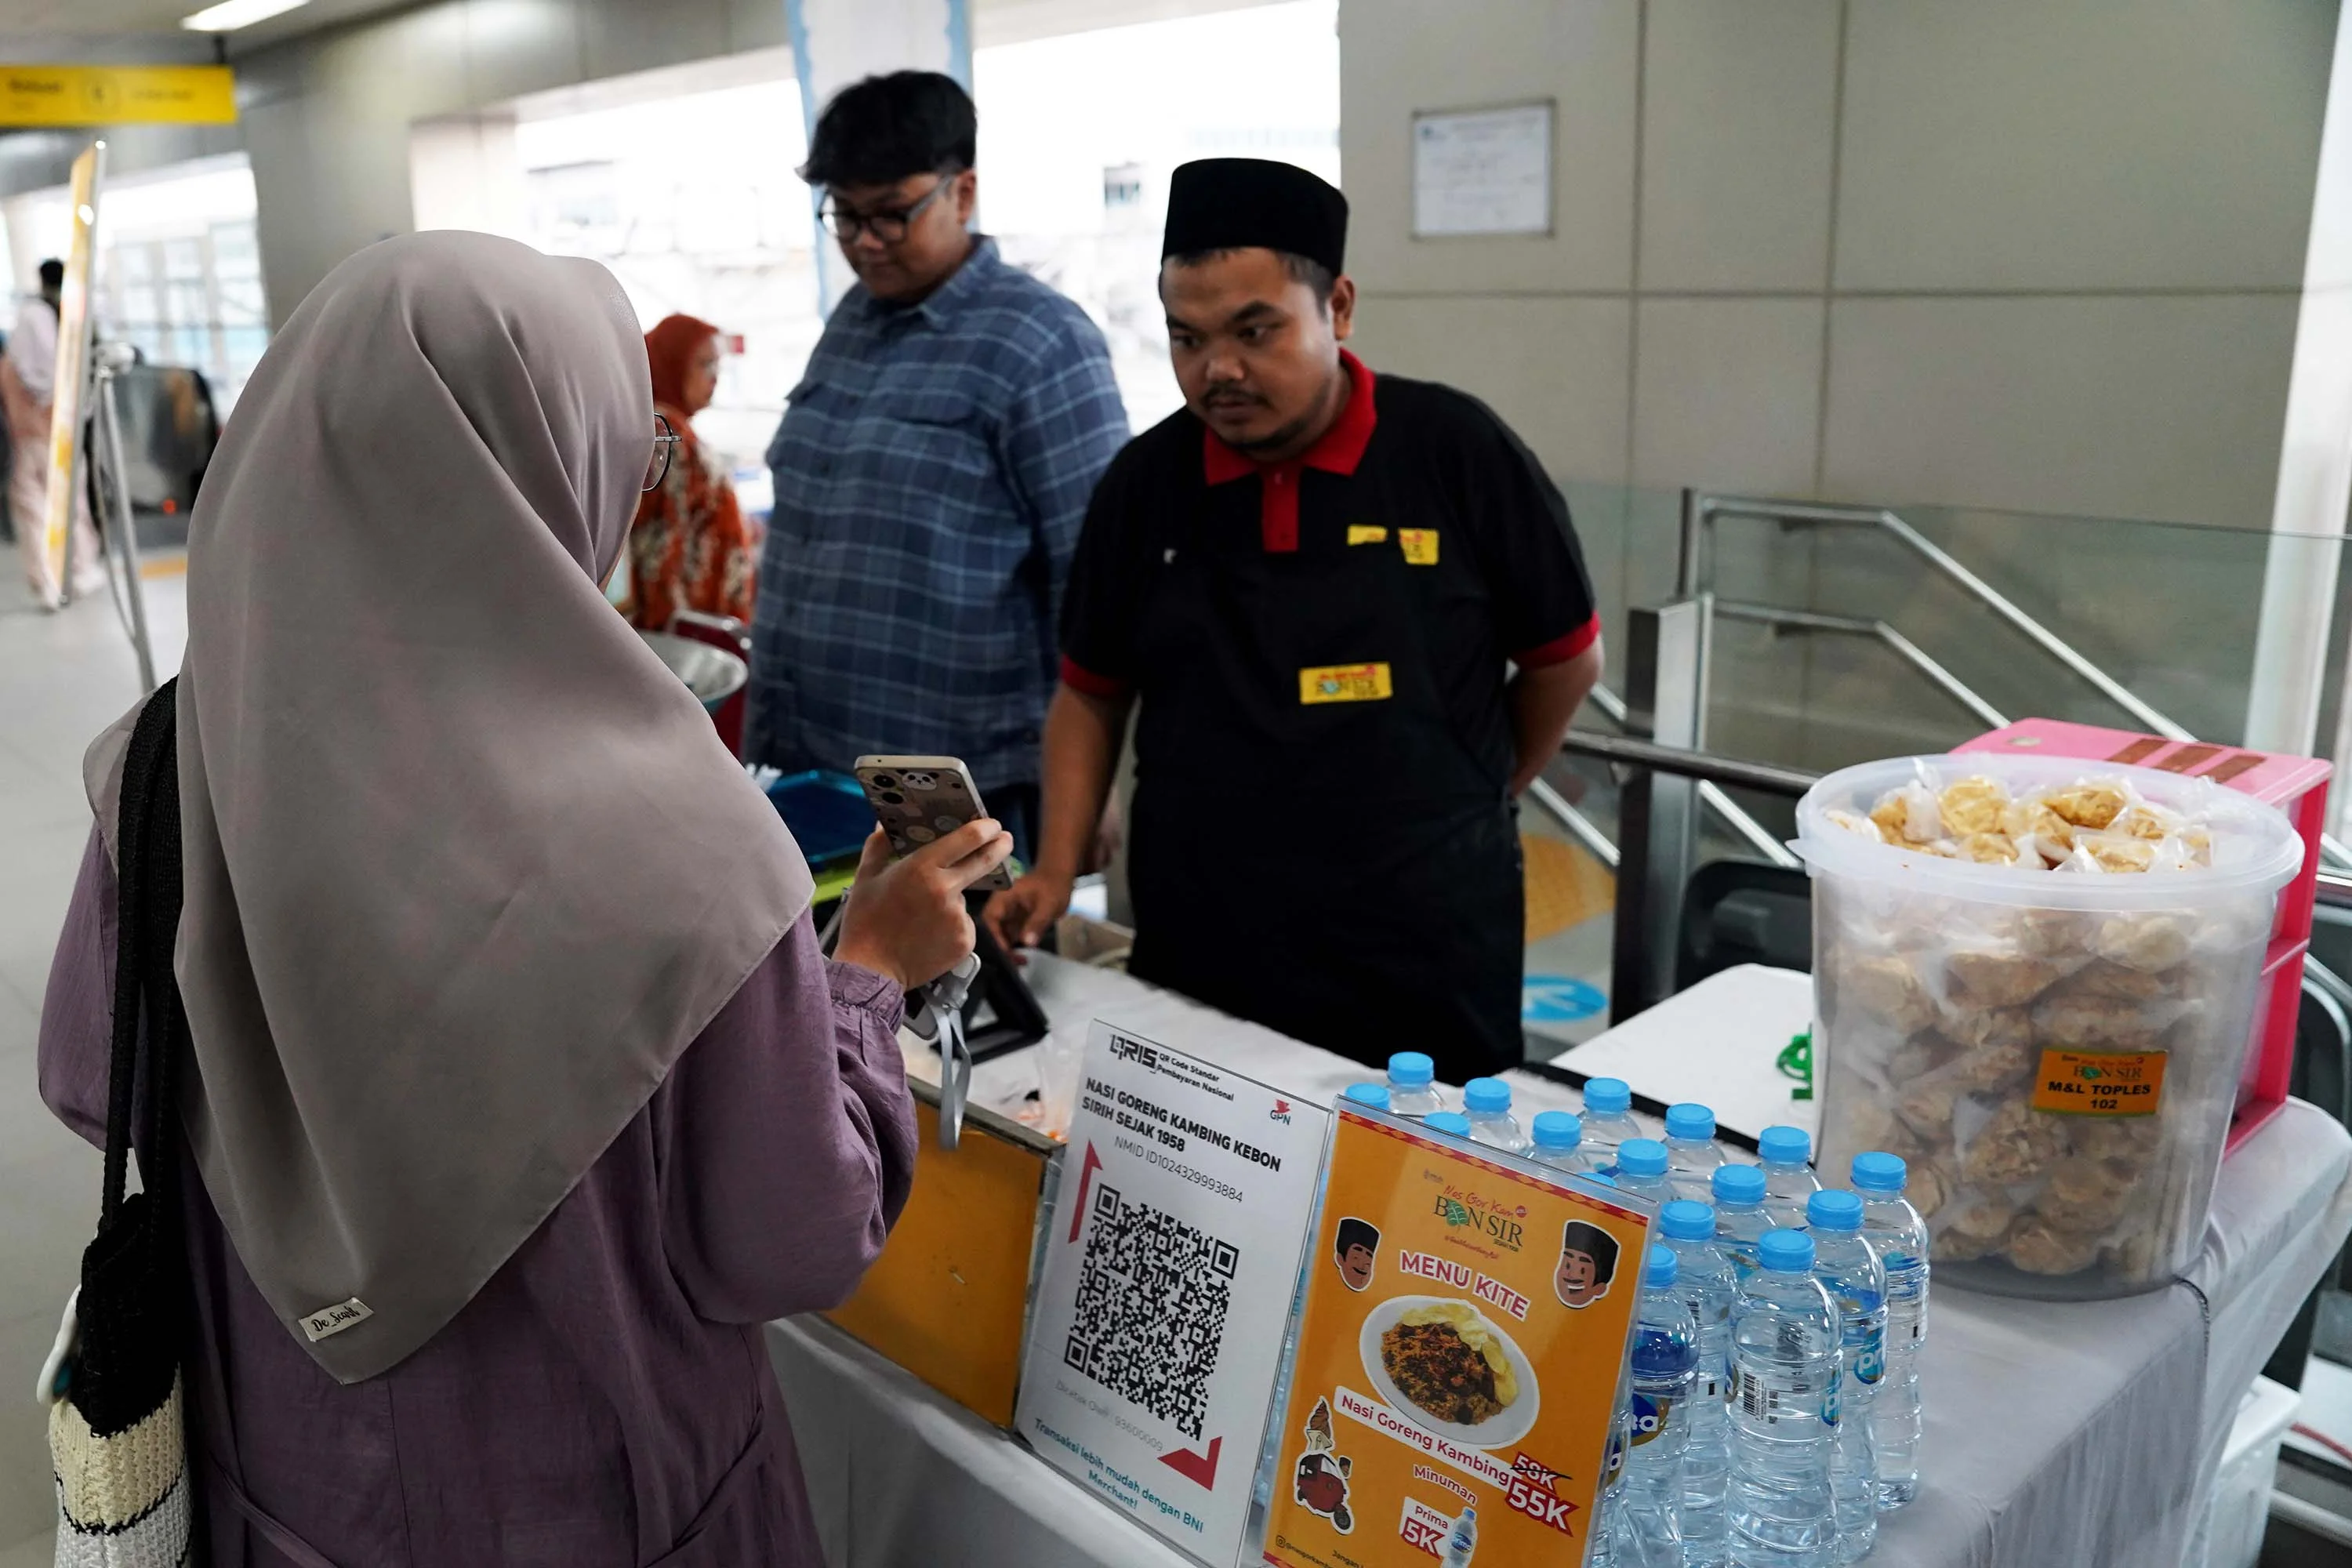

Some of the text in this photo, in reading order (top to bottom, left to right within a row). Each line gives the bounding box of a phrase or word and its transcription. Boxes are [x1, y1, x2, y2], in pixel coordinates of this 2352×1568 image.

[1156, 1064, 1235, 1102] Pembayaran Nasional
[1171, 1058, 1189, 1071] Code
[1190, 1065, 1220, 1082] Standar
[2048, 1081, 2151, 1095] M&L TOPLES
[1270, 1109, 1291, 1126] GPN
[2090, 1099, 2118, 1110] 102
[1082, 1096, 1185, 1152] SIRIH SEJAK 1958
[1086, 1077, 1282, 1172] NASI GORENG KAMBING KEBON
[1114, 1136, 1143, 1158] NMID
[1443, 1185, 1463, 1200] Nas
[1466, 1192, 1488, 1208] Gor
[1401, 1251, 1530, 1319] MENU KITE
[1342, 1395, 1510, 1486] Nasi Goreng Kambing
[1034, 1418, 1204, 1534] Transaksi lebih mudah dengan BNI
[1088, 1470, 1138, 1510] Merchant!
[1414, 1465, 1477, 1504] Minuman
[1415, 1505, 1449, 1530] Prima
[1508, 1481, 1570, 1530] 55K
[1404, 1521, 1439, 1554] 5K
